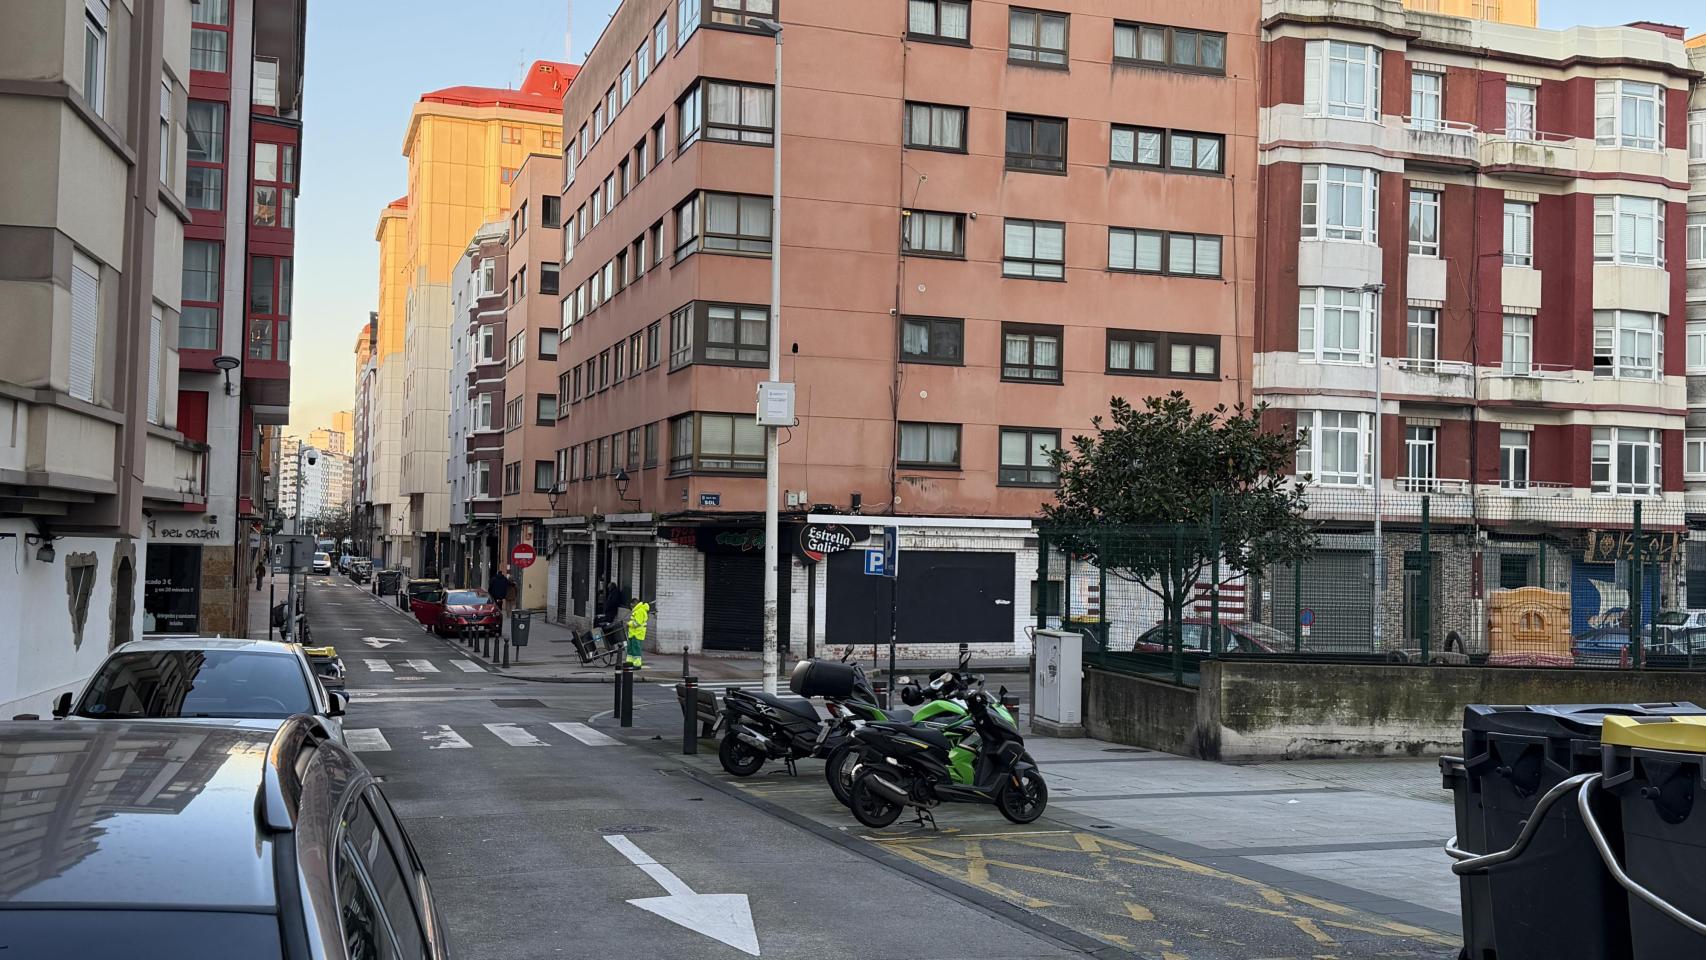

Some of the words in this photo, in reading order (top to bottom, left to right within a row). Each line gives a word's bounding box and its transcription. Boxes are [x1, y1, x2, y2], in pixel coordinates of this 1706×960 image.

[161, 528, 183, 538] DEL
[185, 527, 220, 540] ORZÁN
[808, 526, 850, 546] Estrella
[870, 551, 884, 572] P
